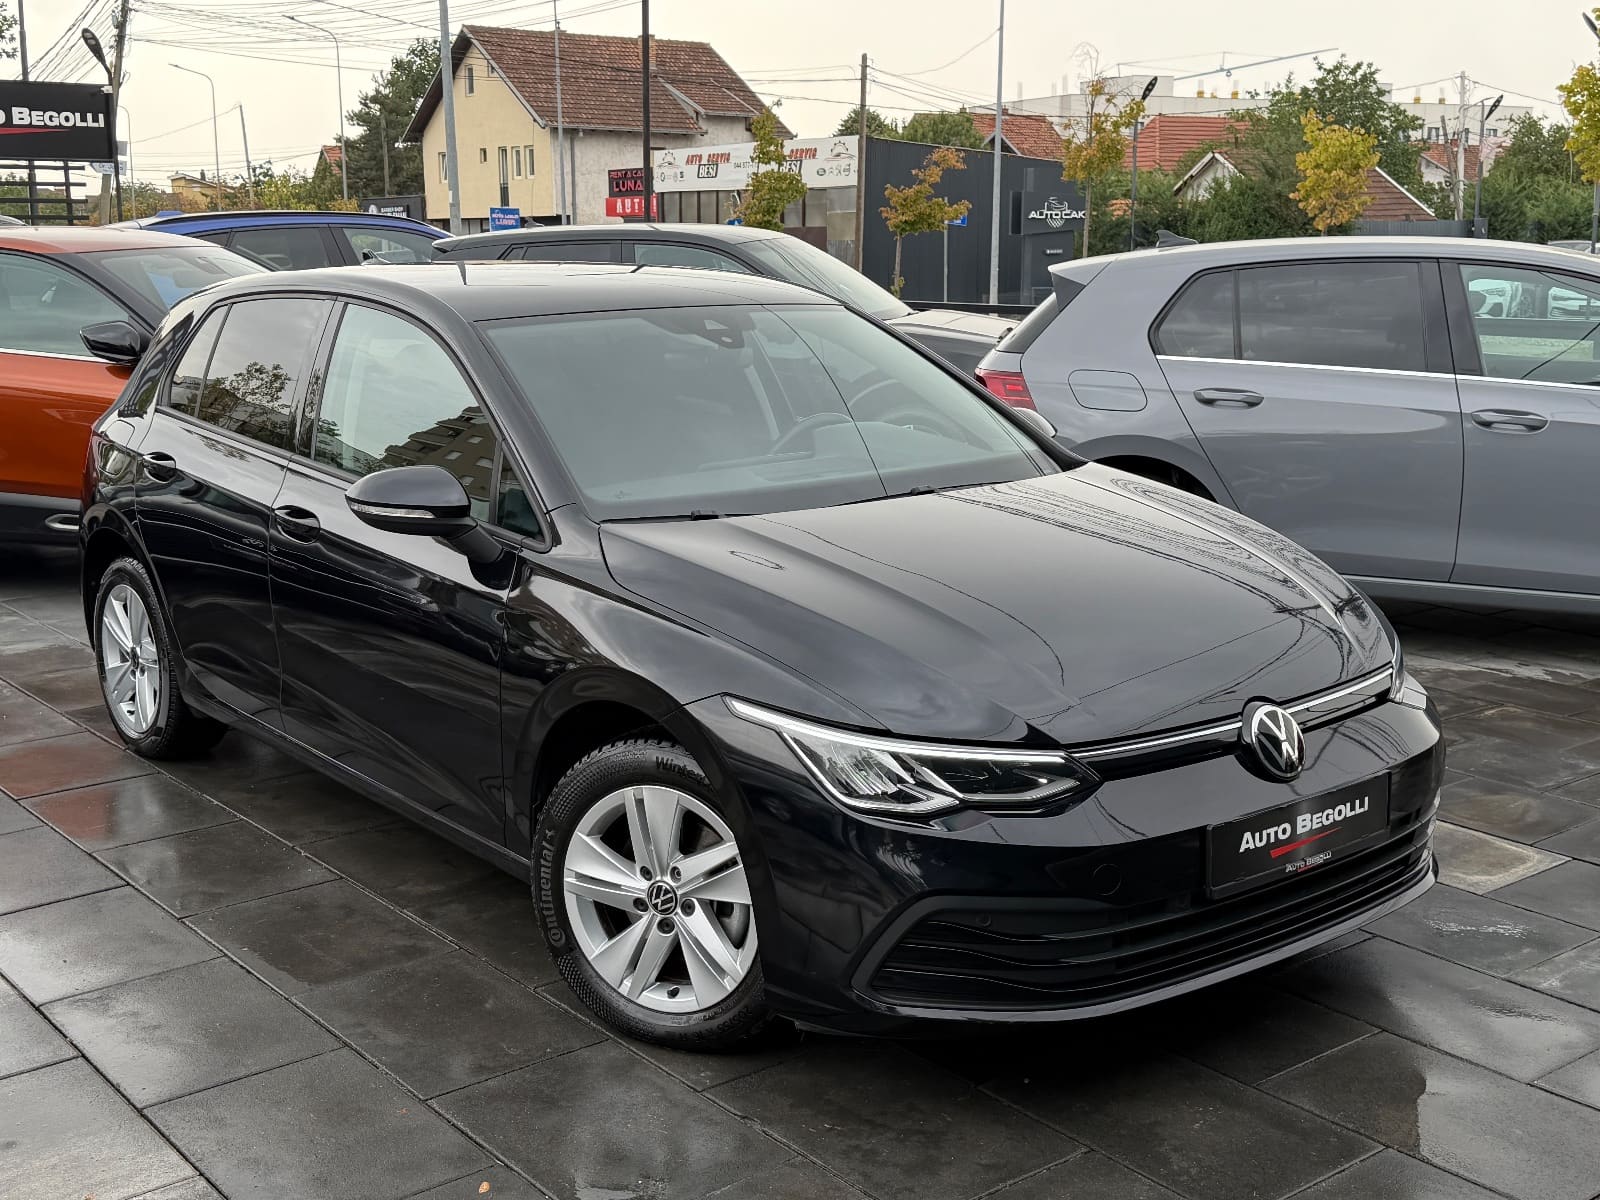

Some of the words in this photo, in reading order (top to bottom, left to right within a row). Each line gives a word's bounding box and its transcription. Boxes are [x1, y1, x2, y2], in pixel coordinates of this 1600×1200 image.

[11, 106, 105, 128] BEGOLLI
[699, 163, 718, 178] BESI
[613, 179, 644, 192] LUNA
[1239, 822, 1292, 853] AUTO
[1296, 796, 1369, 835] BEGOLLI
